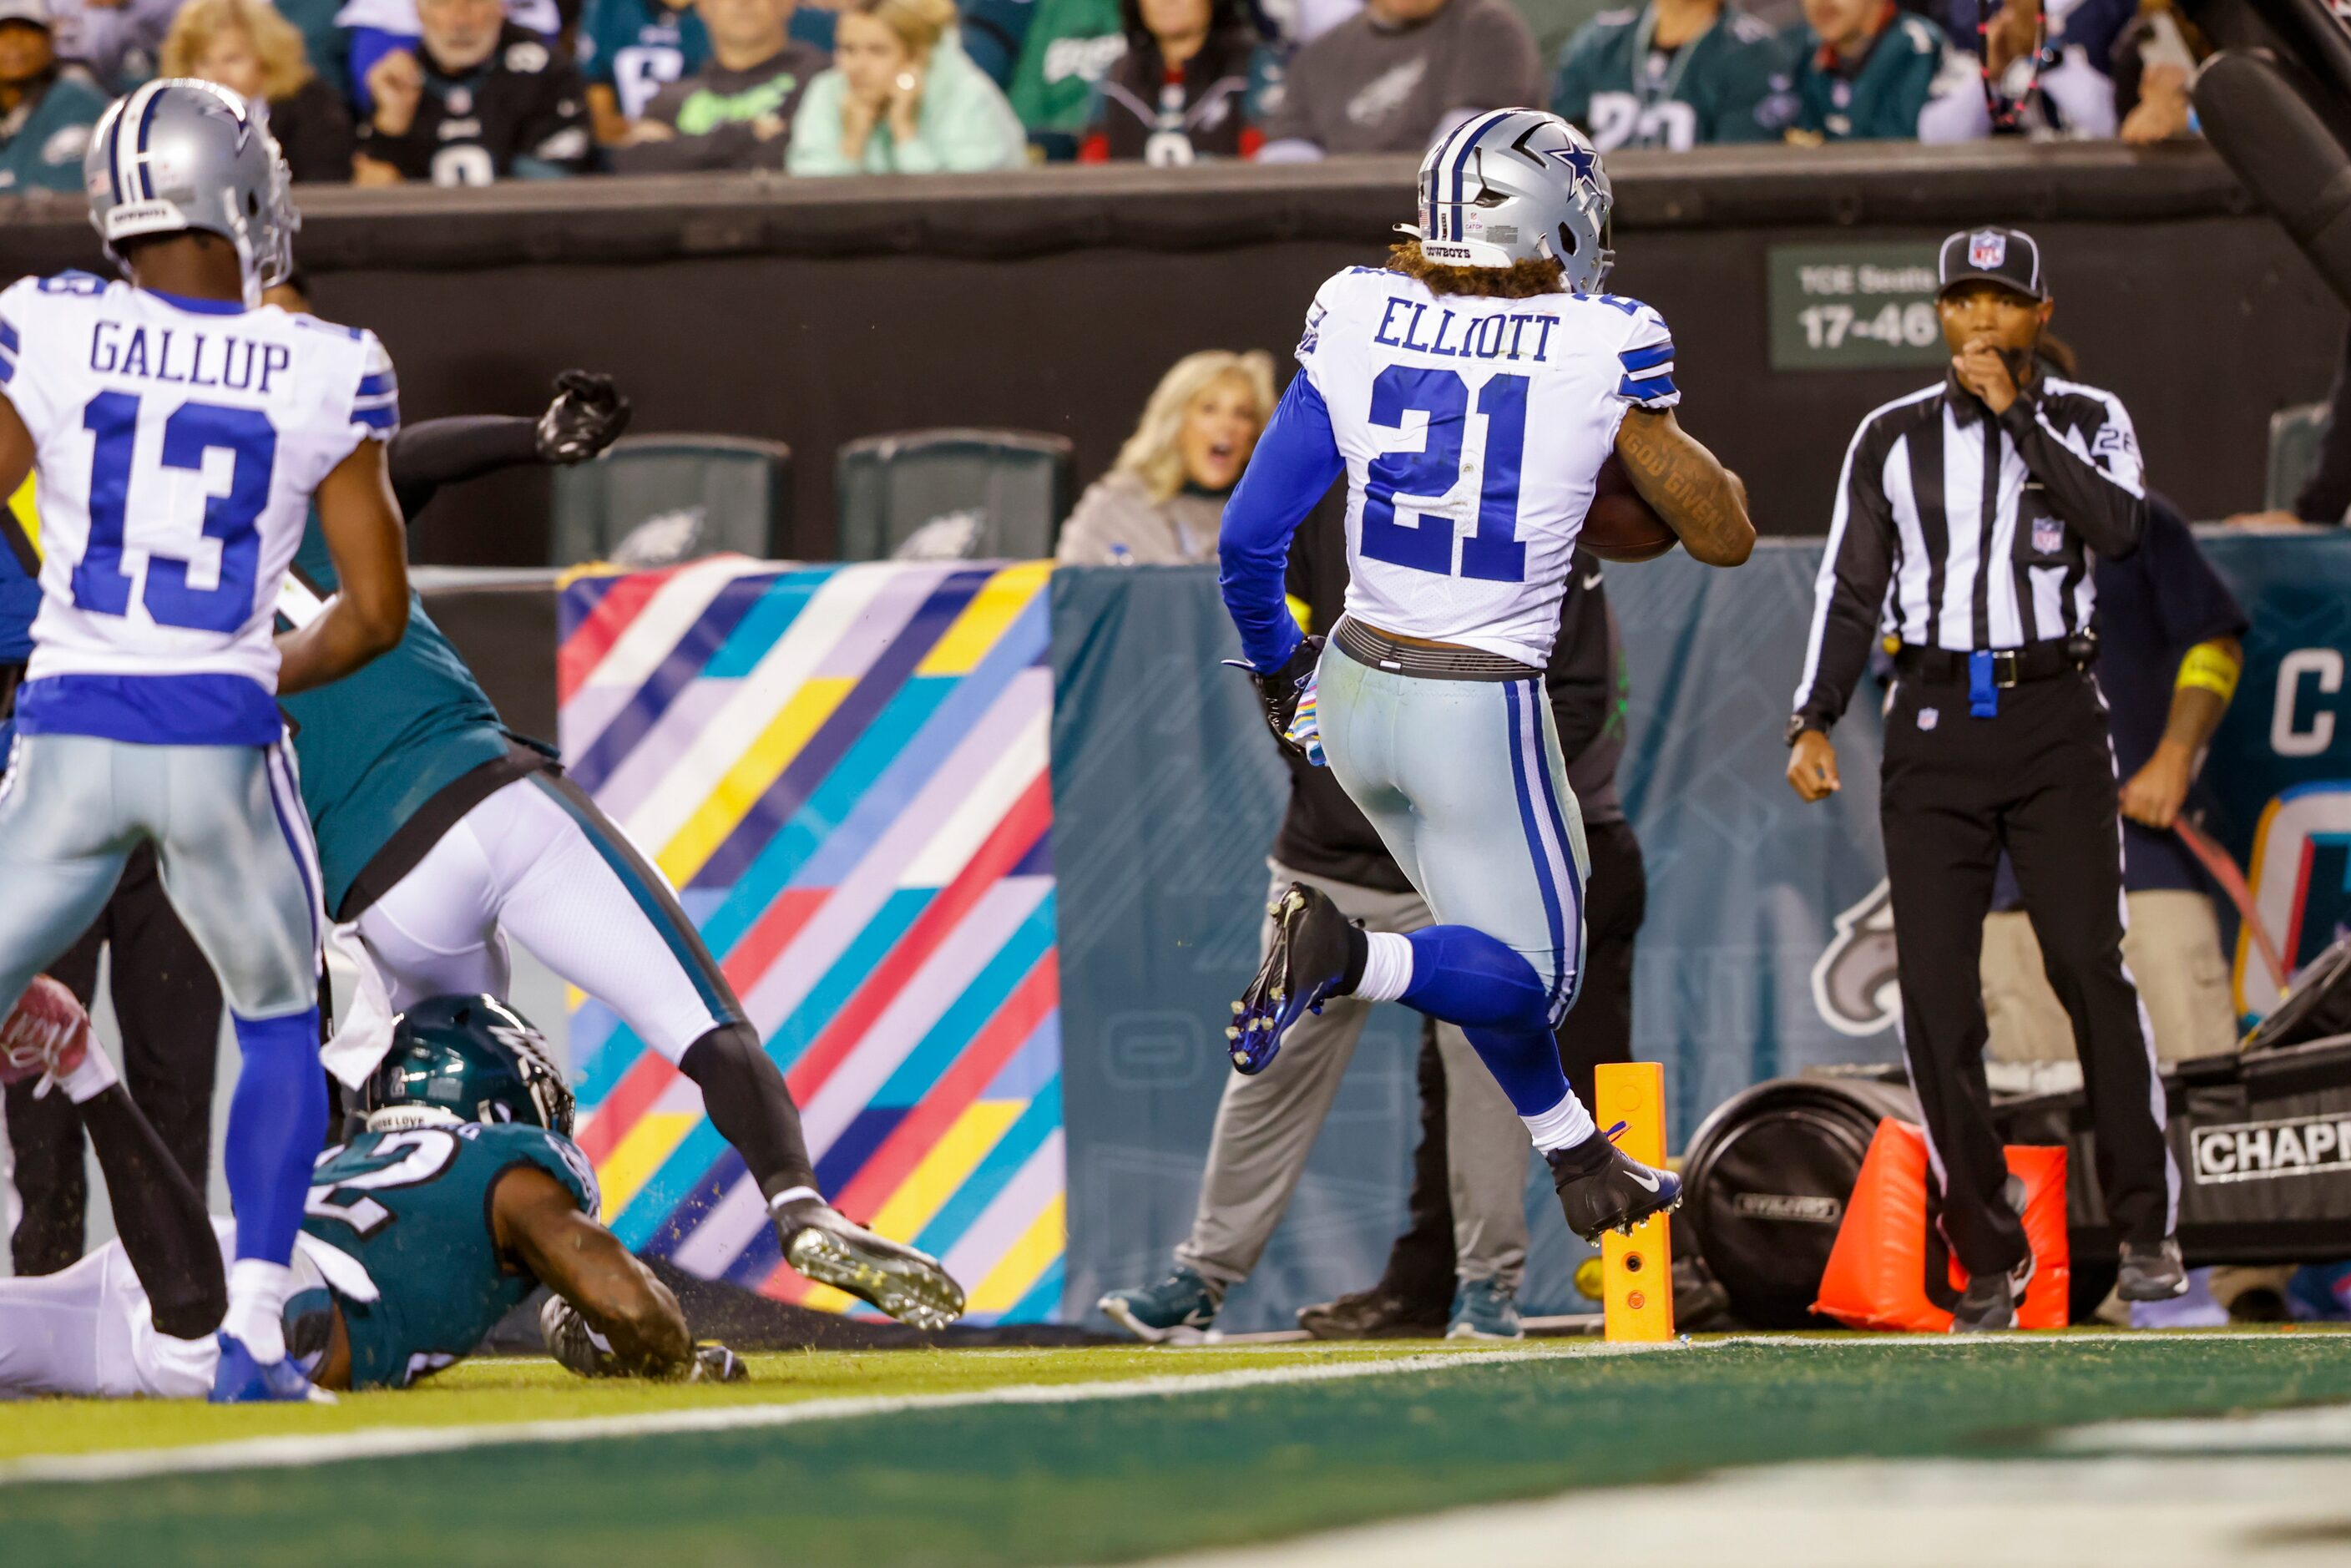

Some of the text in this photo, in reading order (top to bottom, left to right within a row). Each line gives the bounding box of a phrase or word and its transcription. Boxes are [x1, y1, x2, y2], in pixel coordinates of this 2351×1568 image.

[89, 321, 291, 394] GALLUP
[1374, 296, 1560, 363] ELLIOTT
[1798, 302, 1938, 349] 17-46
[1360, 364, 1532, 582] 21
[72, 388, 278, 635] 13
